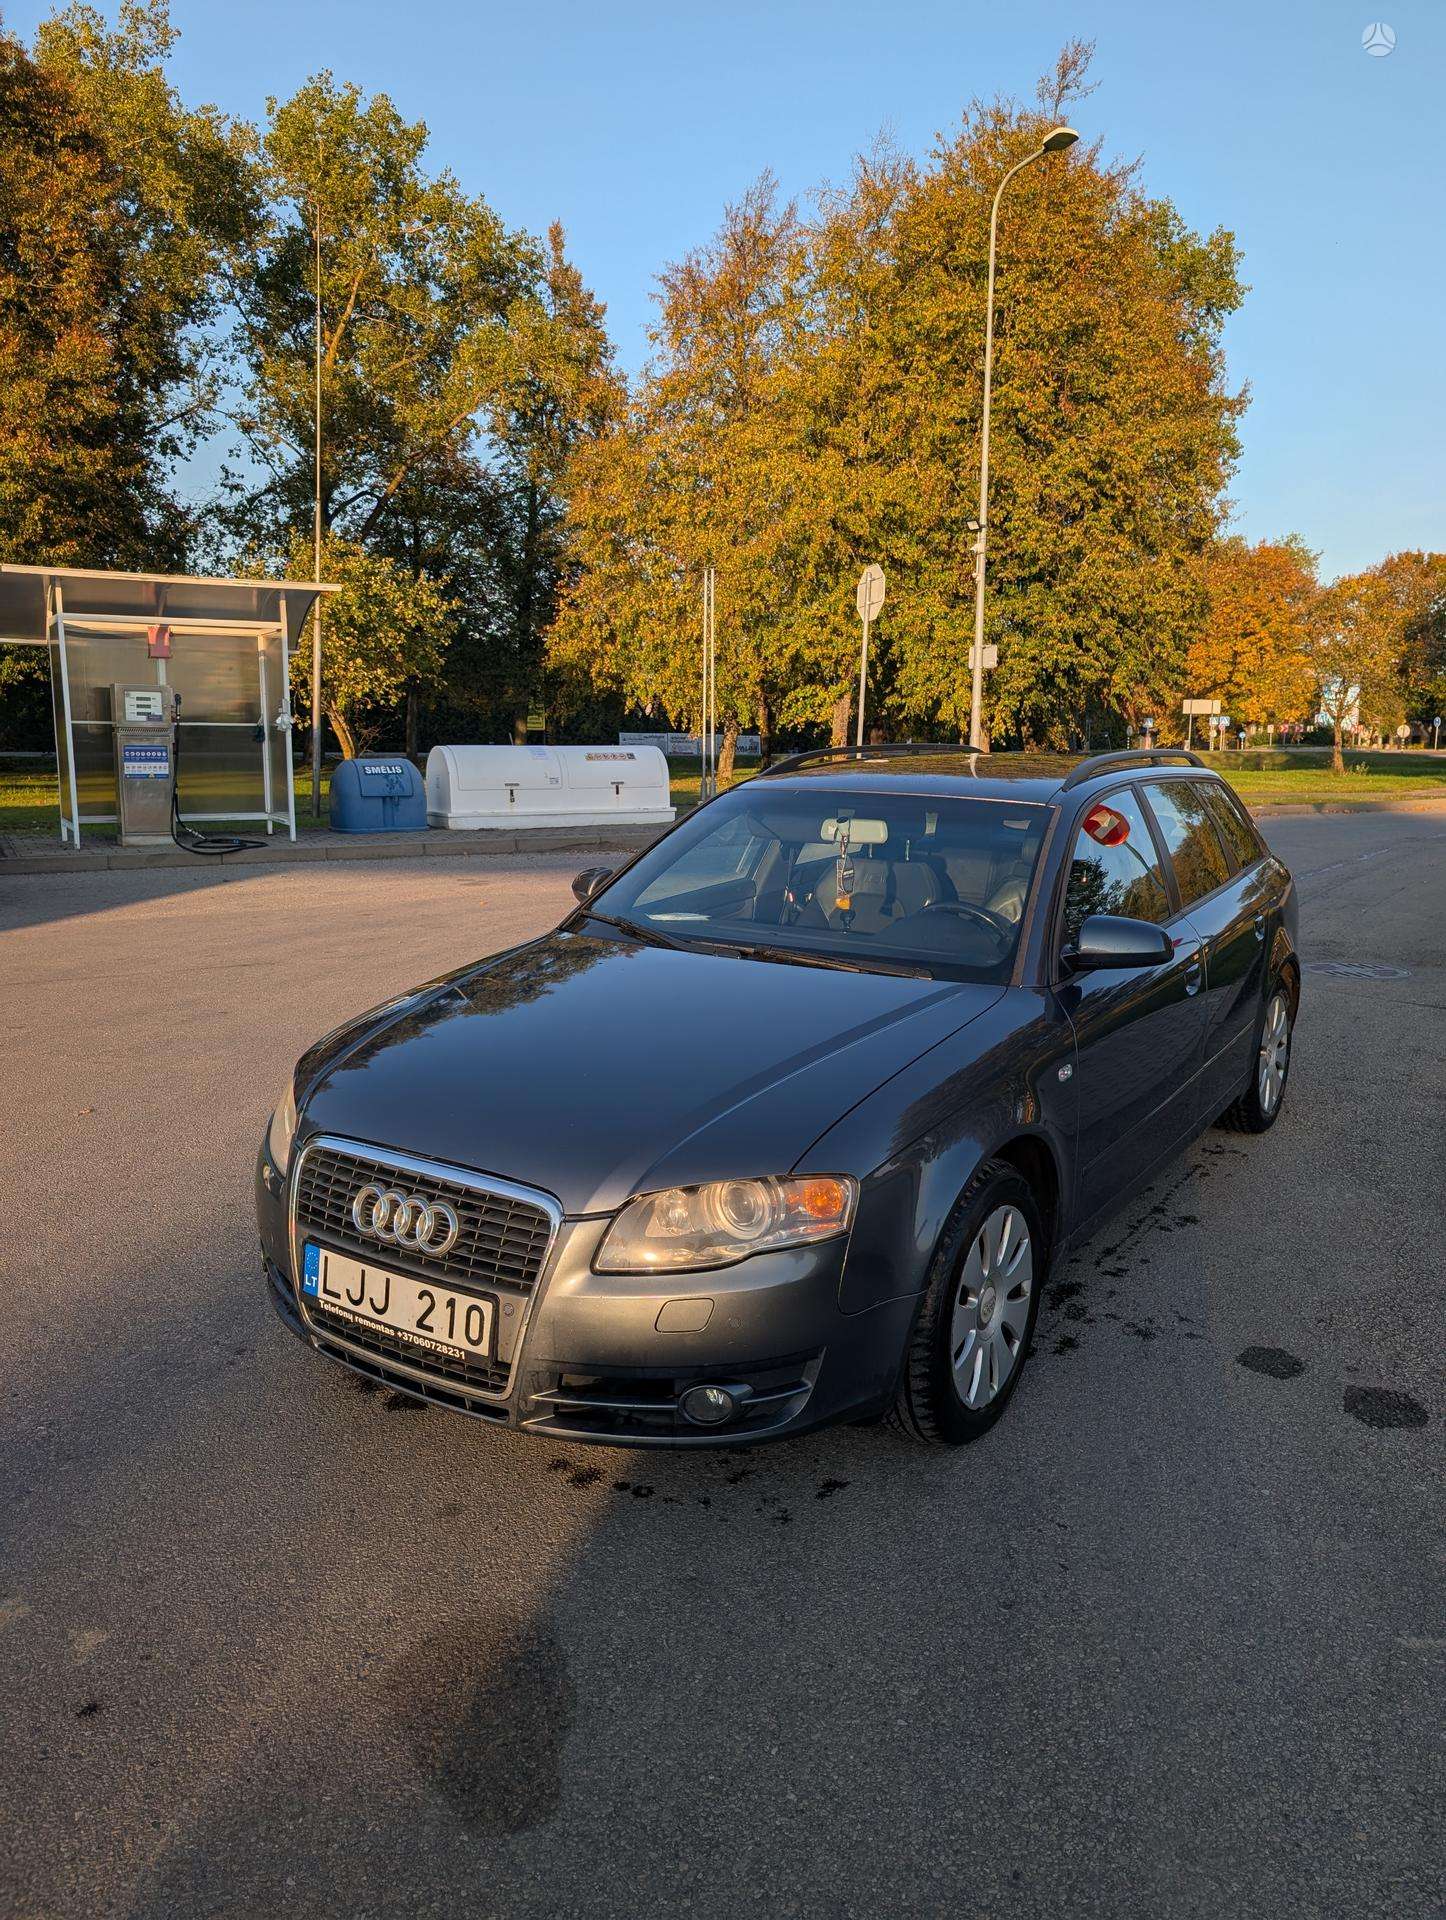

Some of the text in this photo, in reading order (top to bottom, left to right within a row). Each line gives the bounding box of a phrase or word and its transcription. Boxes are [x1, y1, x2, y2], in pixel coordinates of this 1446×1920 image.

[305, 1274, 317, 1287] LT
[323, 1255, 485, 1347] LJJ 210
[355, 1316, 395, 1336] remontas
[397, 1331, 466, 1360] +37060728231
